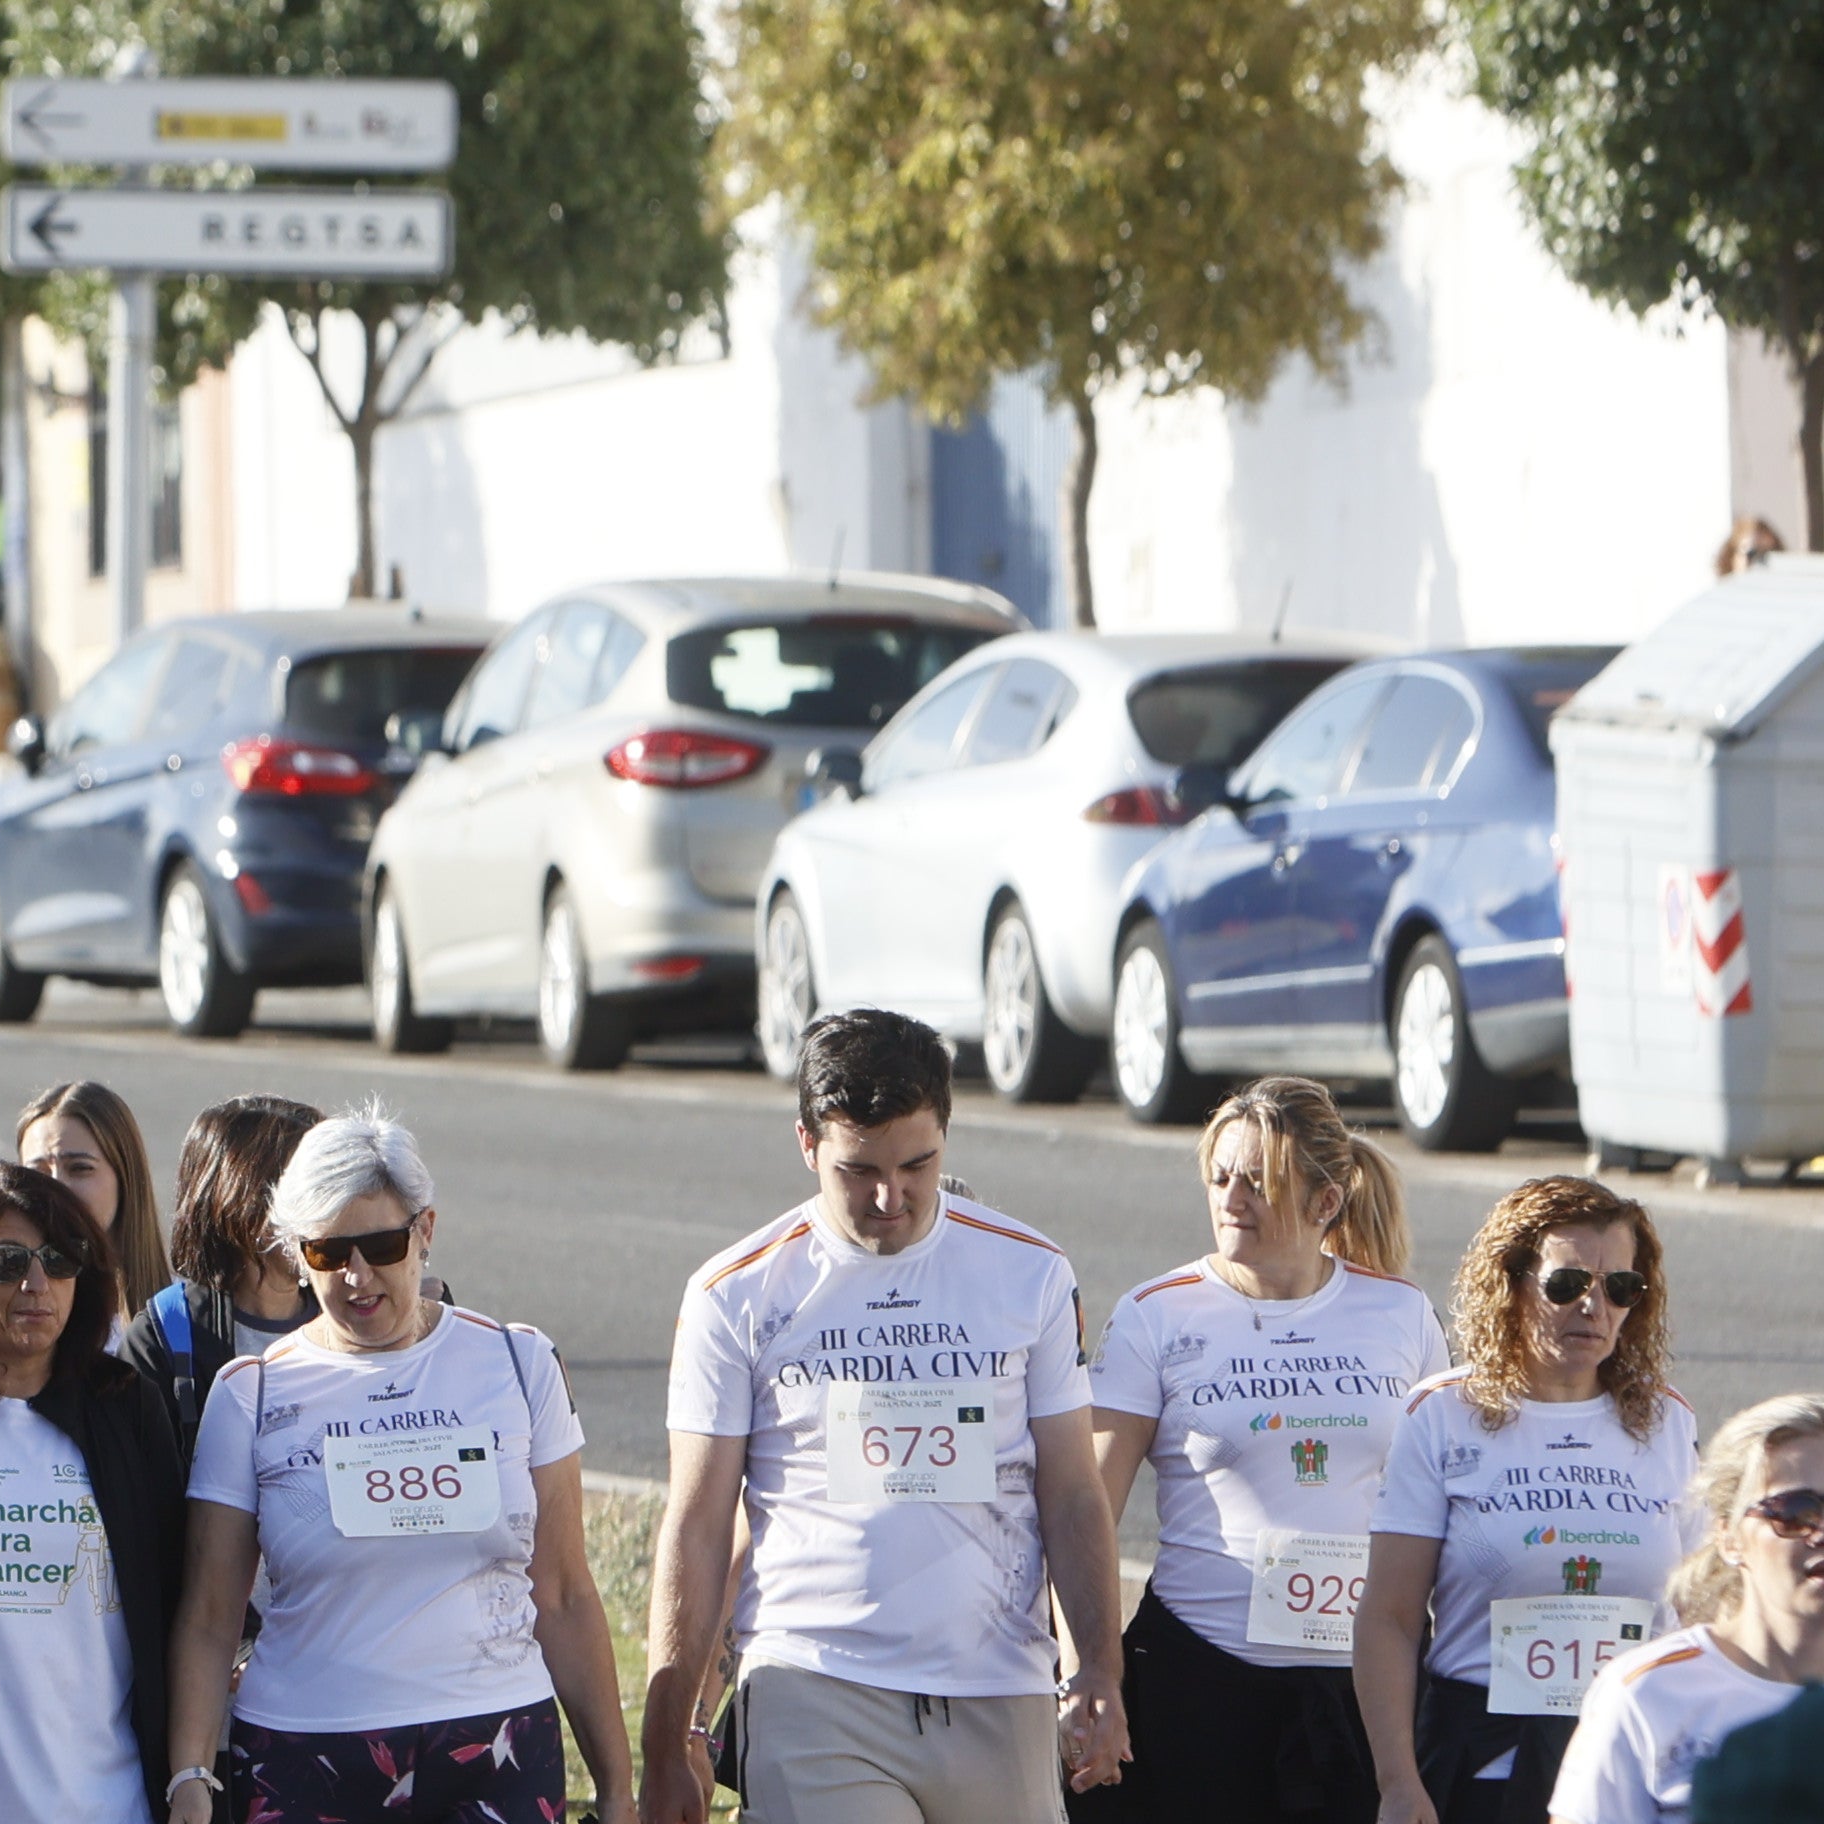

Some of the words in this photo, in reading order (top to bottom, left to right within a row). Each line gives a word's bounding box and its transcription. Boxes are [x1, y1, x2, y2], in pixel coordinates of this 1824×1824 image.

[866, 1299, 921, 1310] TEAMERGY
[819, 1327, 847, 1351] III
[857, 1322, 971, 1348] CARRERA
[778, 1353, 920, 1388] GVARDIA
[931, 1350, 1010, 1379] CIVIL
[1231, 1357, 1256, 1374] III
[1263, 1355, 1368, 1374] CARRERA
[1191, 1376, 1326, 1406] GVARDIA
[326, 1420, 351, 1438] III
[359, 1408, 464, 1435] CARRERA
[1285, 1412, 1369, 1429] Iberdrola
[862, 1425, 957, 1467] 673
[365, 1464, 462, 1503] 886
[1506, 1467, 1530, 1486] III
[1539, 1465, 1637, 1489] CARRERA
[413, 1504, 444, 1515] grupo
[1560, 1529, 1640, 1545] Iberdrola
[1286, 1572, 1367, 1616] 929
[1527, 1639, 1616, 1680] 615
